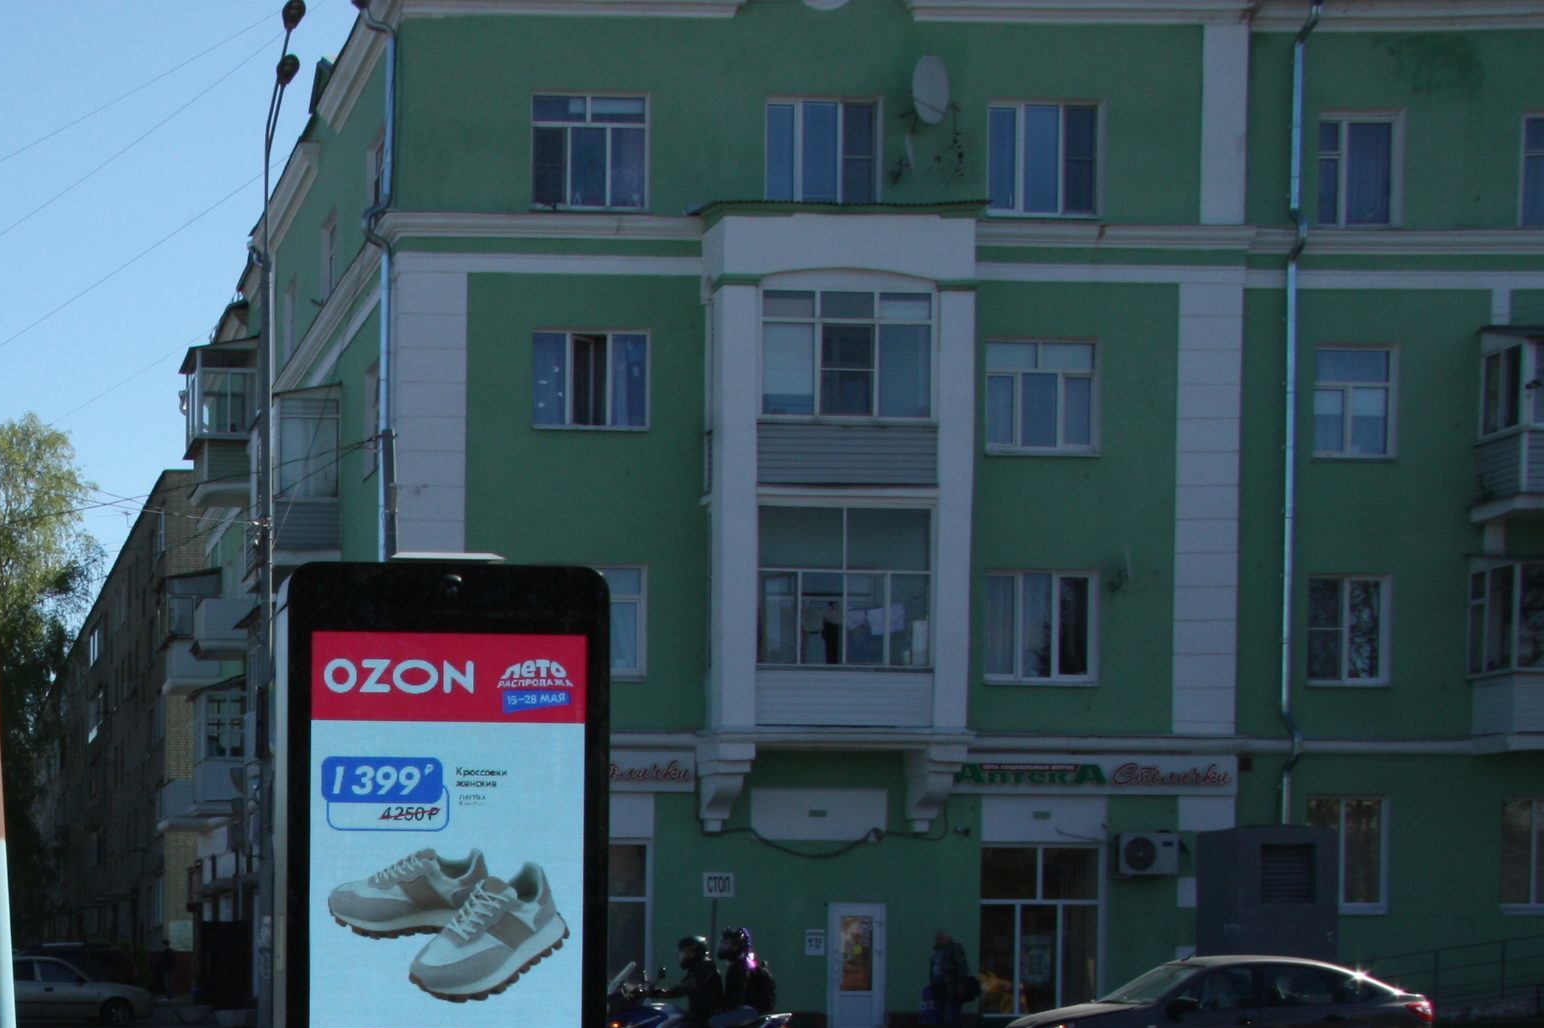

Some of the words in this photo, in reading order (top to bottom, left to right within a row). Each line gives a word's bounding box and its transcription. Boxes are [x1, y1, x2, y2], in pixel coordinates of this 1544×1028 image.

[323, 658, 475, 694] OZON
[497, 678, 574, 688] РАСПРОДАЖА
[539, 692, 566, 704] МАЯ
[456, 767, 508, 778] Кроссовки
[707, 876, 731, 893] СТОП
